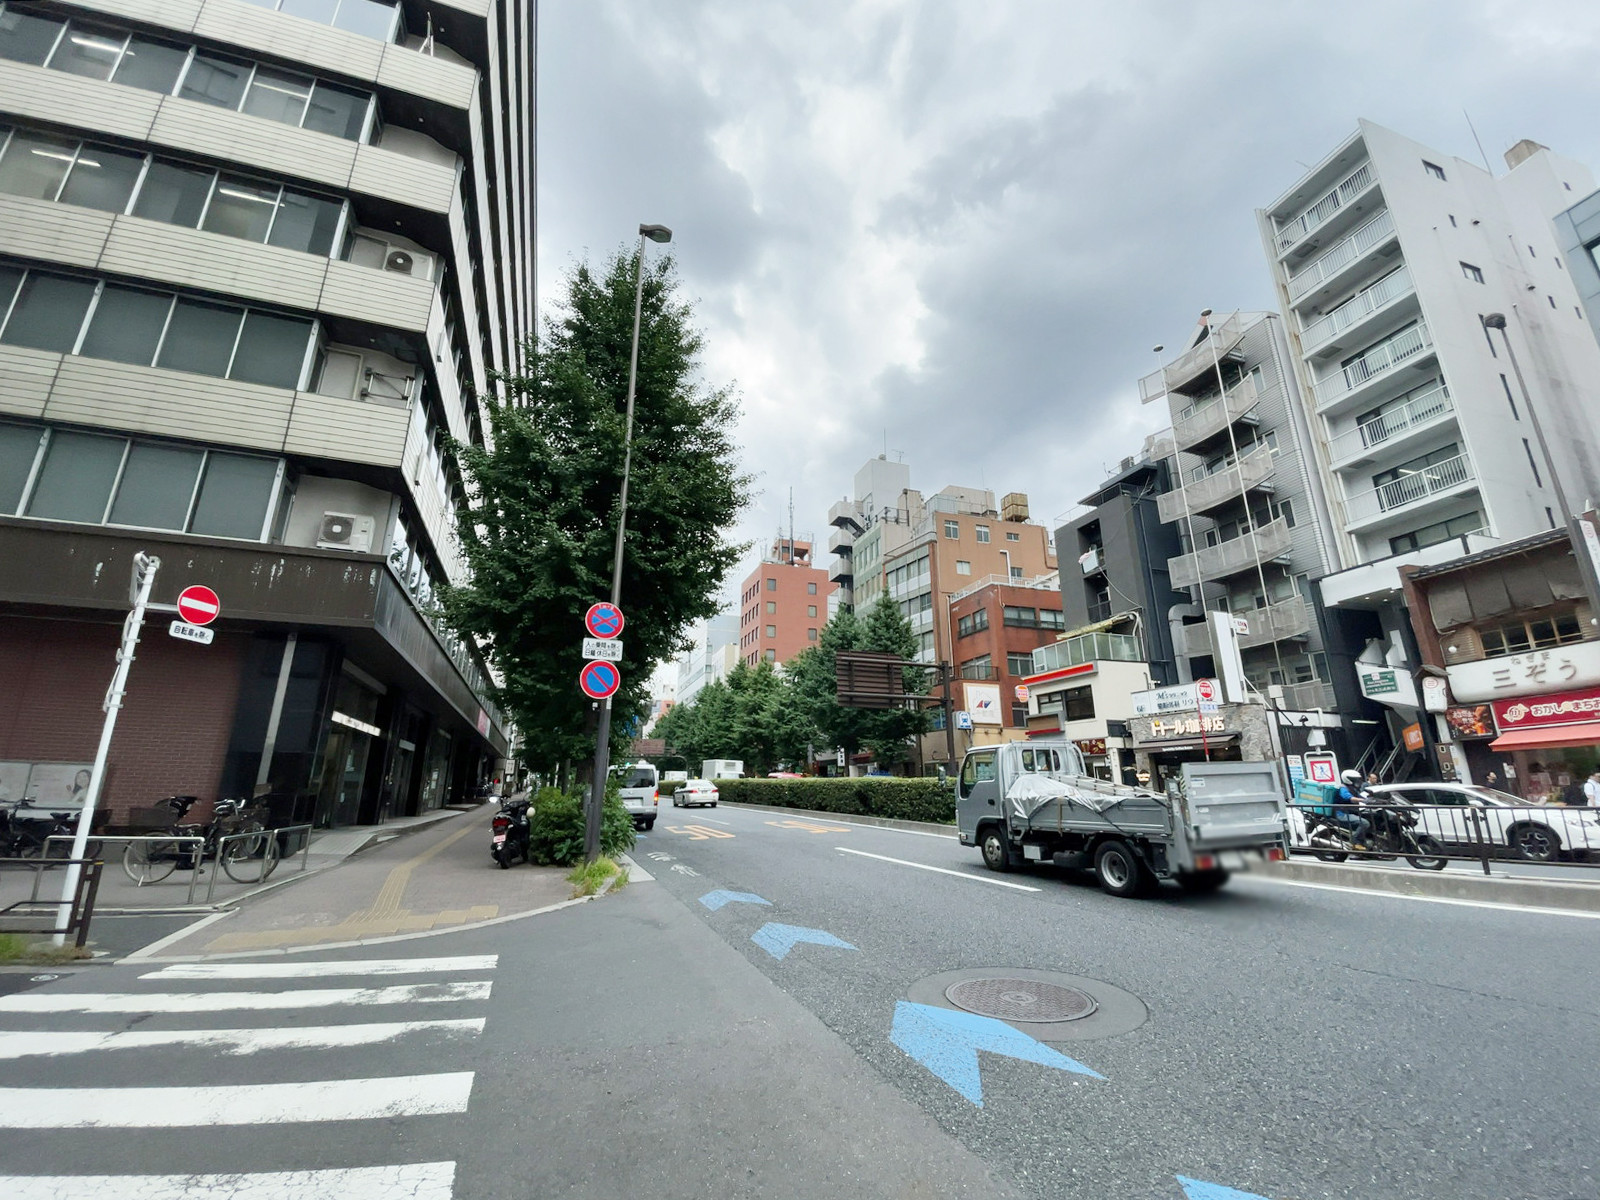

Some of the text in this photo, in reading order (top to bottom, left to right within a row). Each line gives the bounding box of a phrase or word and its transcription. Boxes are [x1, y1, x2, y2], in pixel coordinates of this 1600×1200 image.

[174, 625, 209, 640] 自転車を除く
[1492, 658, 1577, 689] 三ぞう
[1151, 716, 1225, 737] ドトール珈琲店
[663, 824, 736, 841] 50
